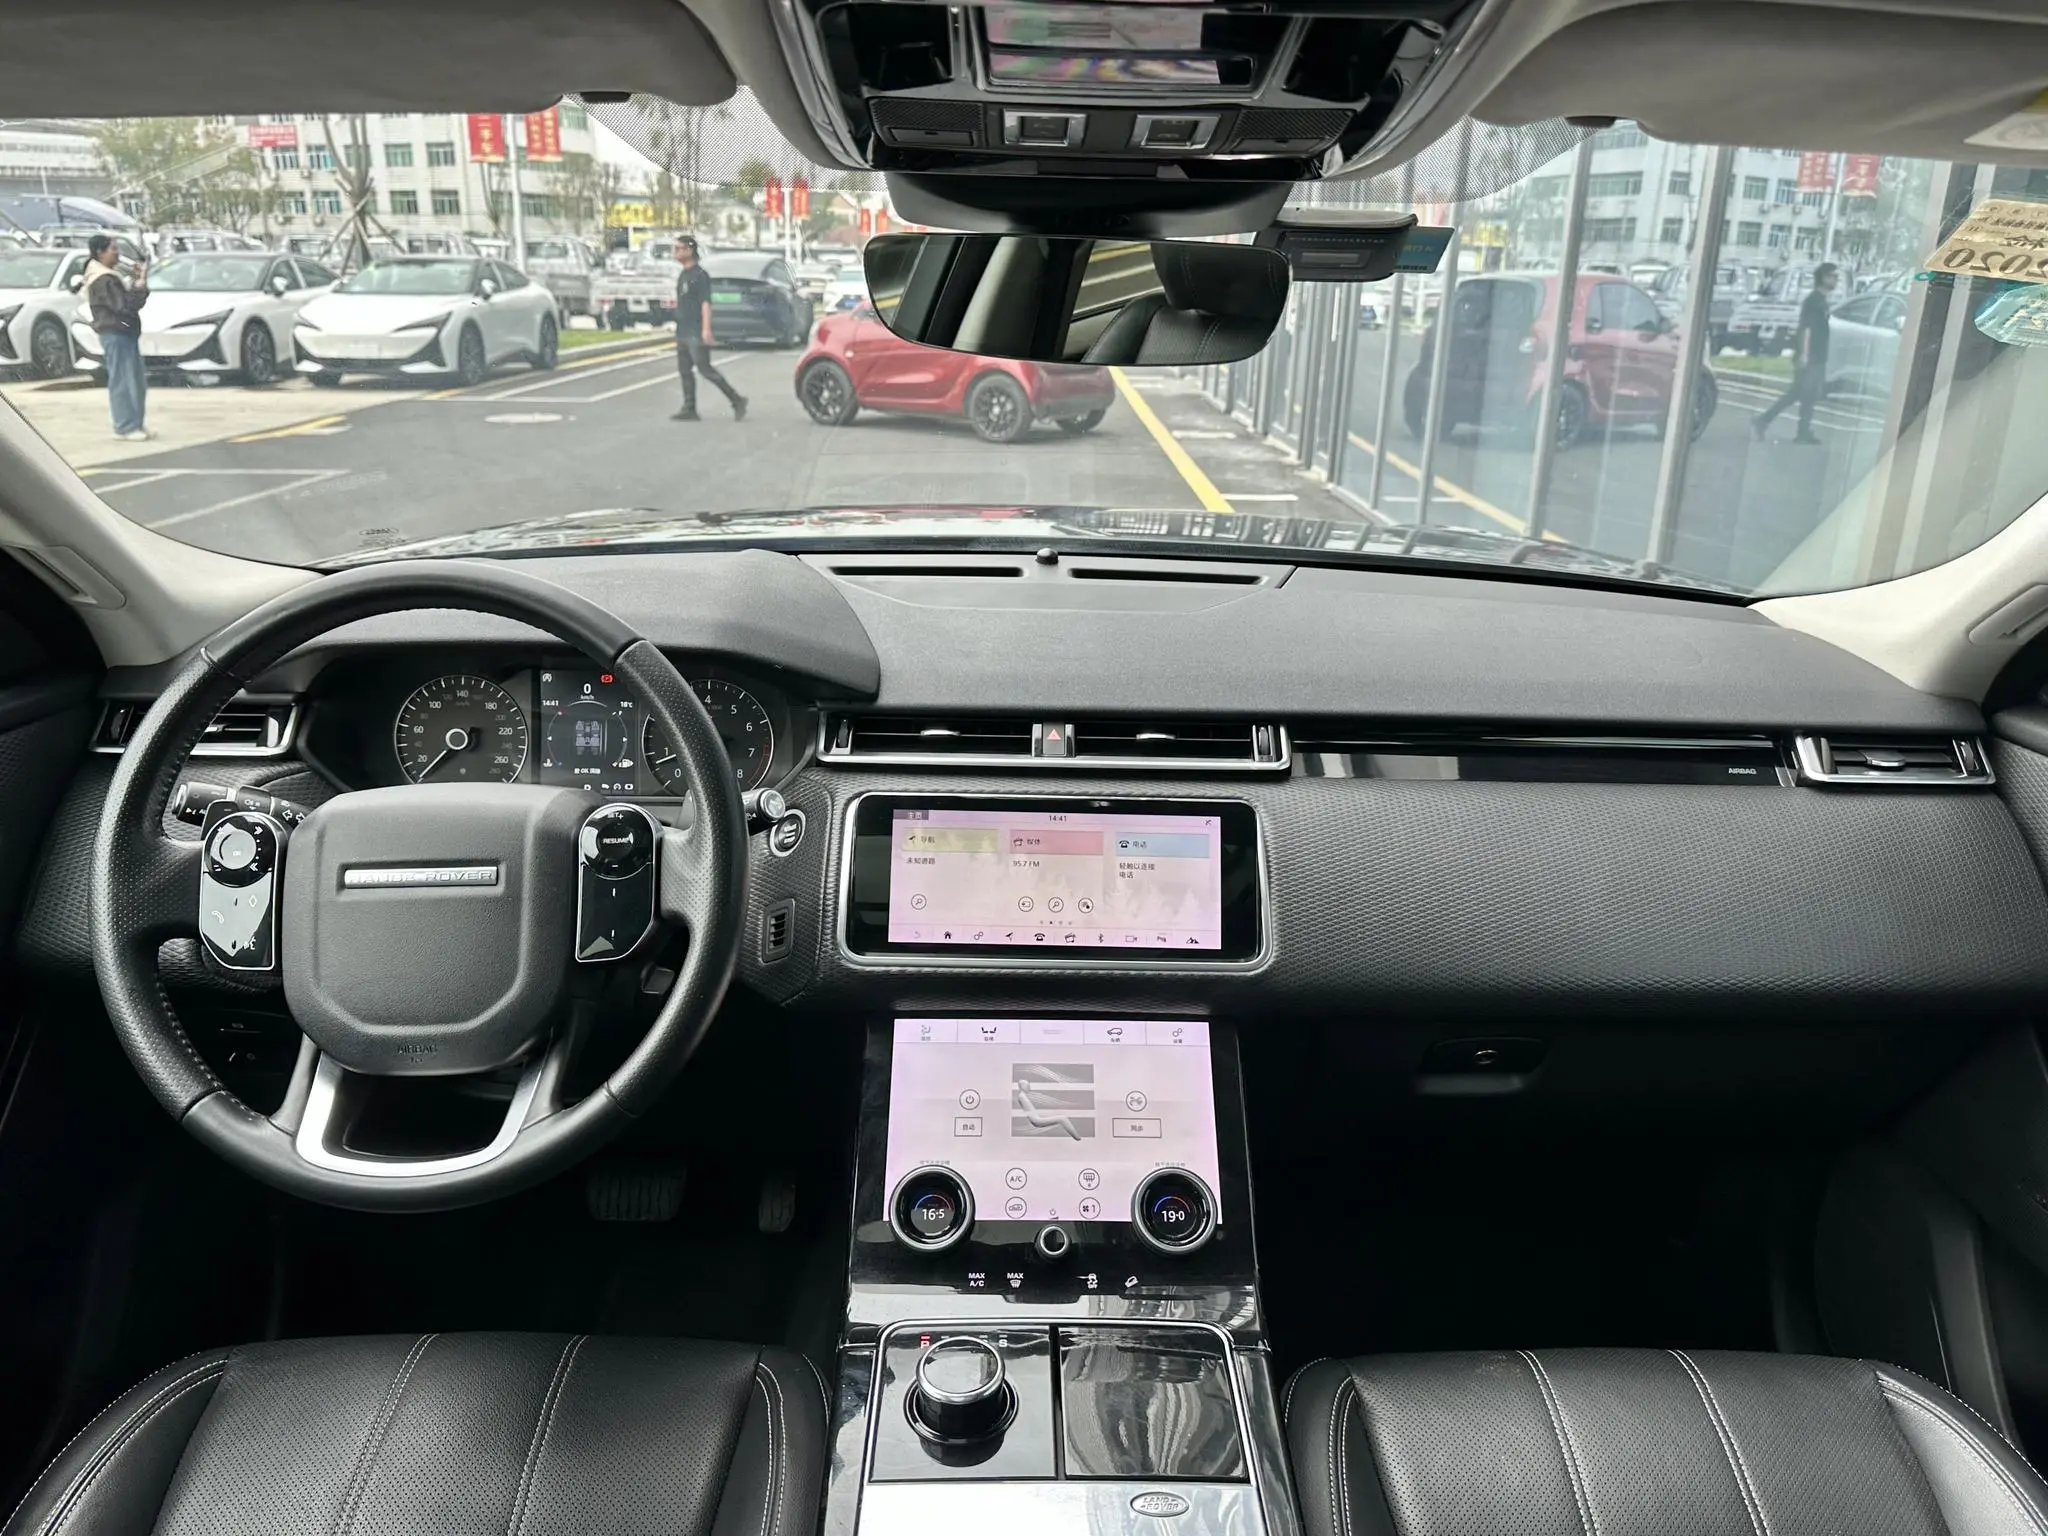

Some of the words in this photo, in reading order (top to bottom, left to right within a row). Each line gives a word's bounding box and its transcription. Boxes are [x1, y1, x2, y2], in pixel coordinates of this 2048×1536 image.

[583, 683, 592, 694] 0
[456, 689, 469, 698] 140
[704, 694, 712, 704] 4
[428, 701, 442, 709] 100
[485, 701, 498, 710] 180
[730, 704, 738, 715] 5
[413, 726, 424, 734] 60
[498, 727, 513, 735] 220
[746, 722, 753, 732] 6
[747, 747, 755, 758] 7
[418, 754, 428, 763] 20
[494, 755, 509, 764] 260
[674, 768, 682, 778] 0
[736, 768, 744, 779] 8
[1728, 767, 1757, 775] AIRBAG
[1048, 815, 1068, 823] 14:41
[424, 871, 493, 882] ROVER
[1009, 1175, 1023, 1183] A/C
[920, 1341, 930, 1349] P
[998, 1339, 1008, 1348] S
